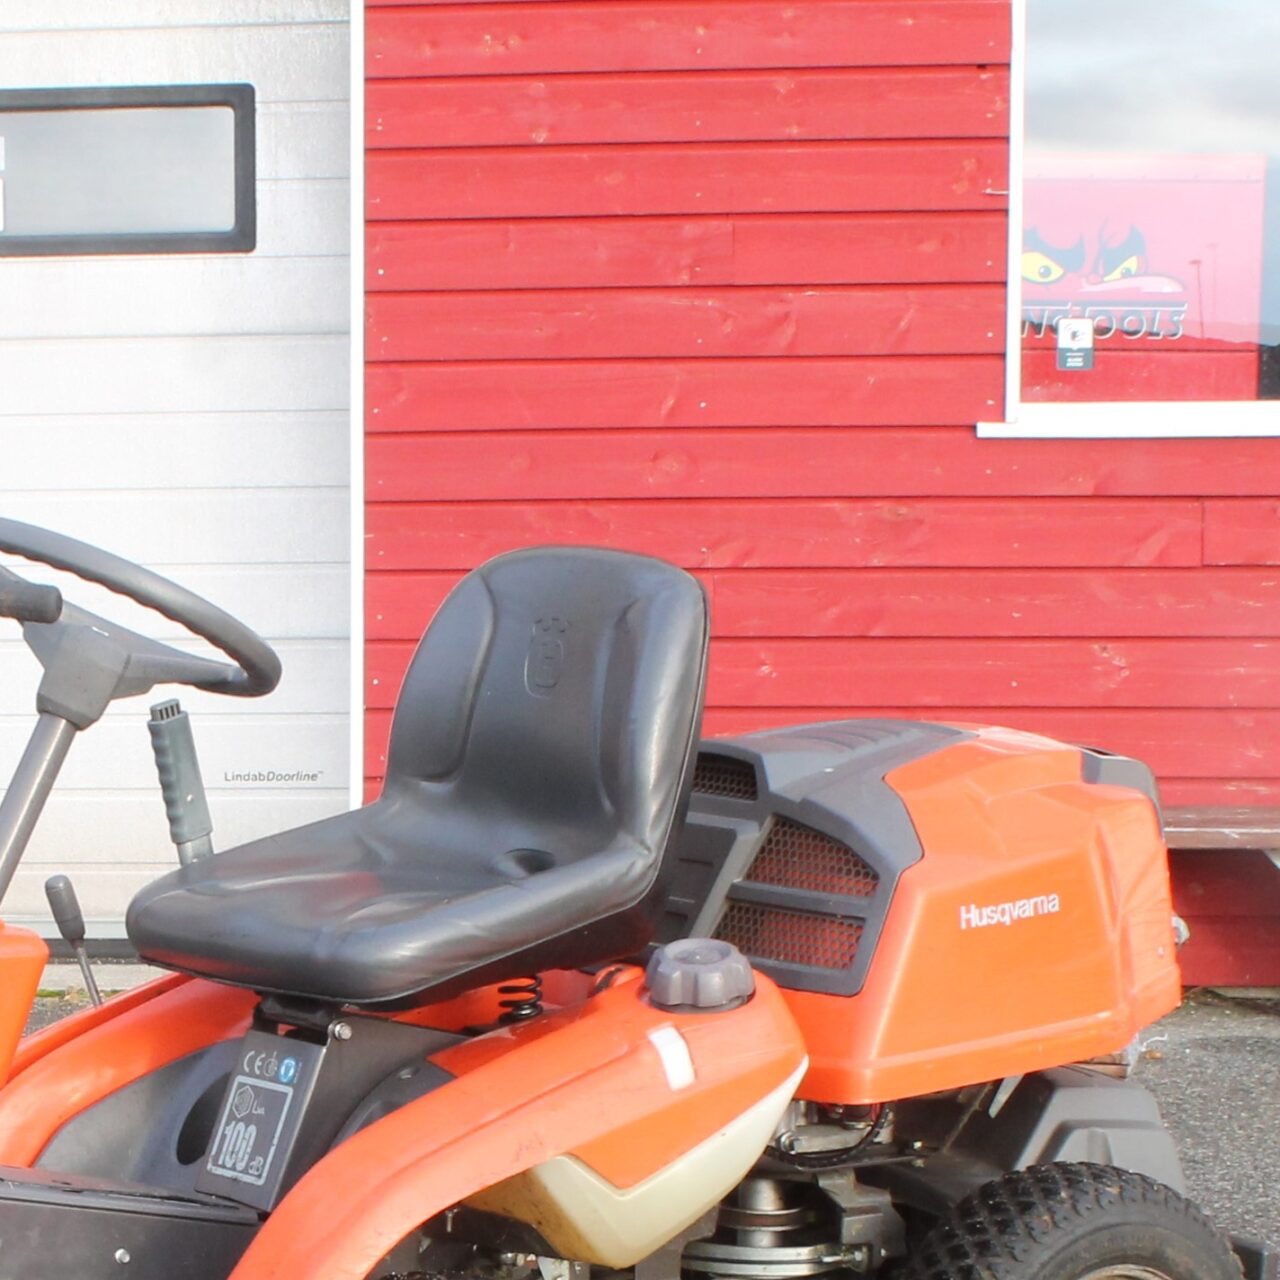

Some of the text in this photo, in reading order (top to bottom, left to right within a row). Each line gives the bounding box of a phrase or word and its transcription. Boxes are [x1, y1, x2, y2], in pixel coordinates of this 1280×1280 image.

[960, 893, 1060, 930] Husqvarna
[217, 1120, 265, 1175] 100 dB
